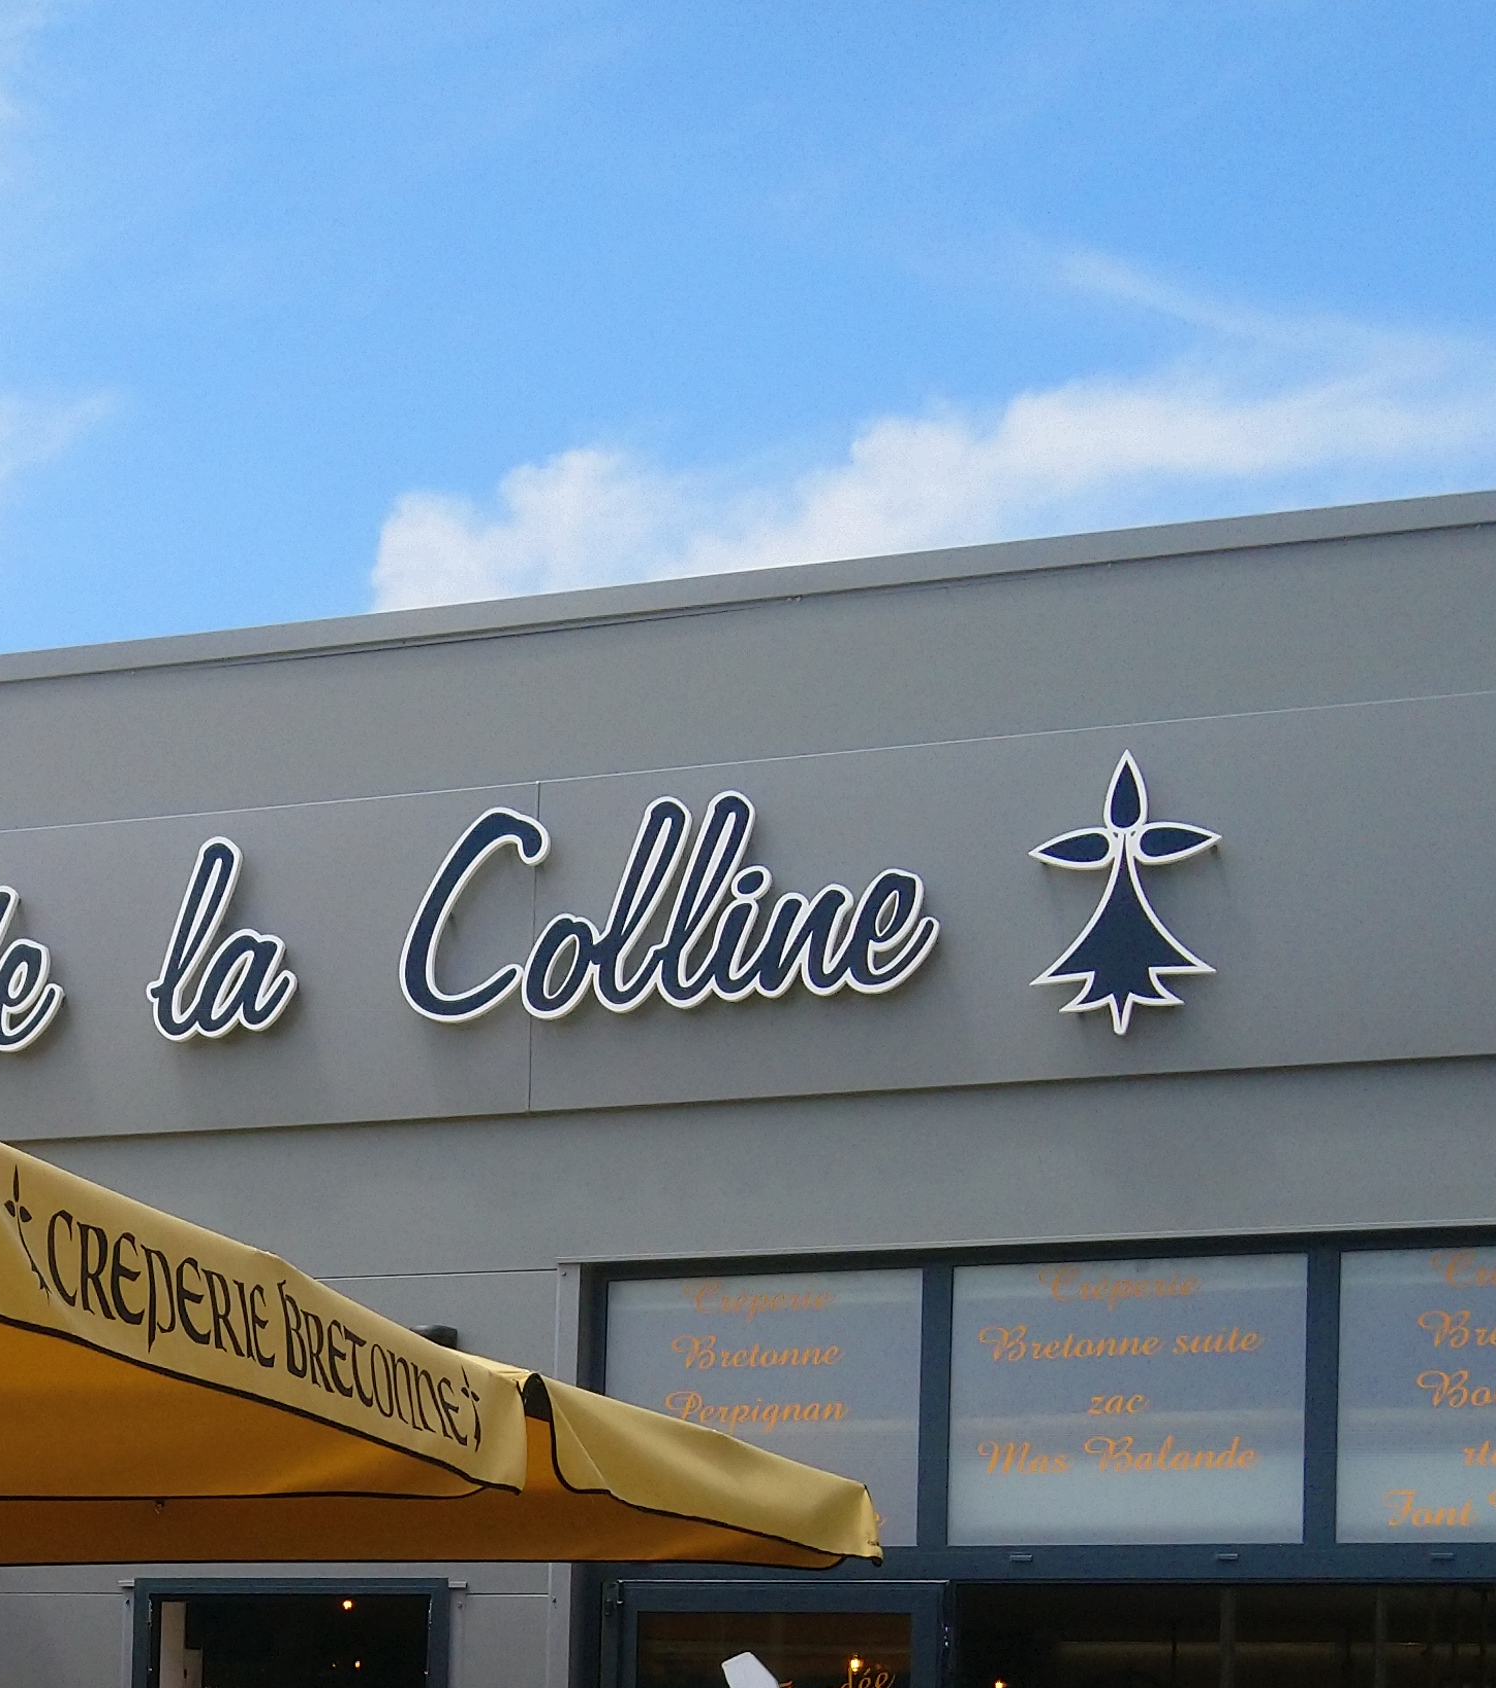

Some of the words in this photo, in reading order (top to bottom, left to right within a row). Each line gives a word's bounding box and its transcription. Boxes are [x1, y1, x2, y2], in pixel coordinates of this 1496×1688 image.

[147, 836, 298, 1042] la
[400, 790, 939, 1023] Colline
[1038, 1266, 1202, 1311] Crêperie
[46, 1209, 276, 1368] CREPERIE
[277, 1280, 469, 1446] BRETONNE
[979, 1324, 1163, 1362] Bretonne
[1172, 1327, 1264, 1354] suite
[672, 1335, 844, 1369] Bretonne
[665, 1391, 848, 1434] Perpignan
[1088, 1393, 1150, 1415] zac
[977, 1441, 1071, 1475] Mas
[1084, 1435, 1261, 1472] Balande
